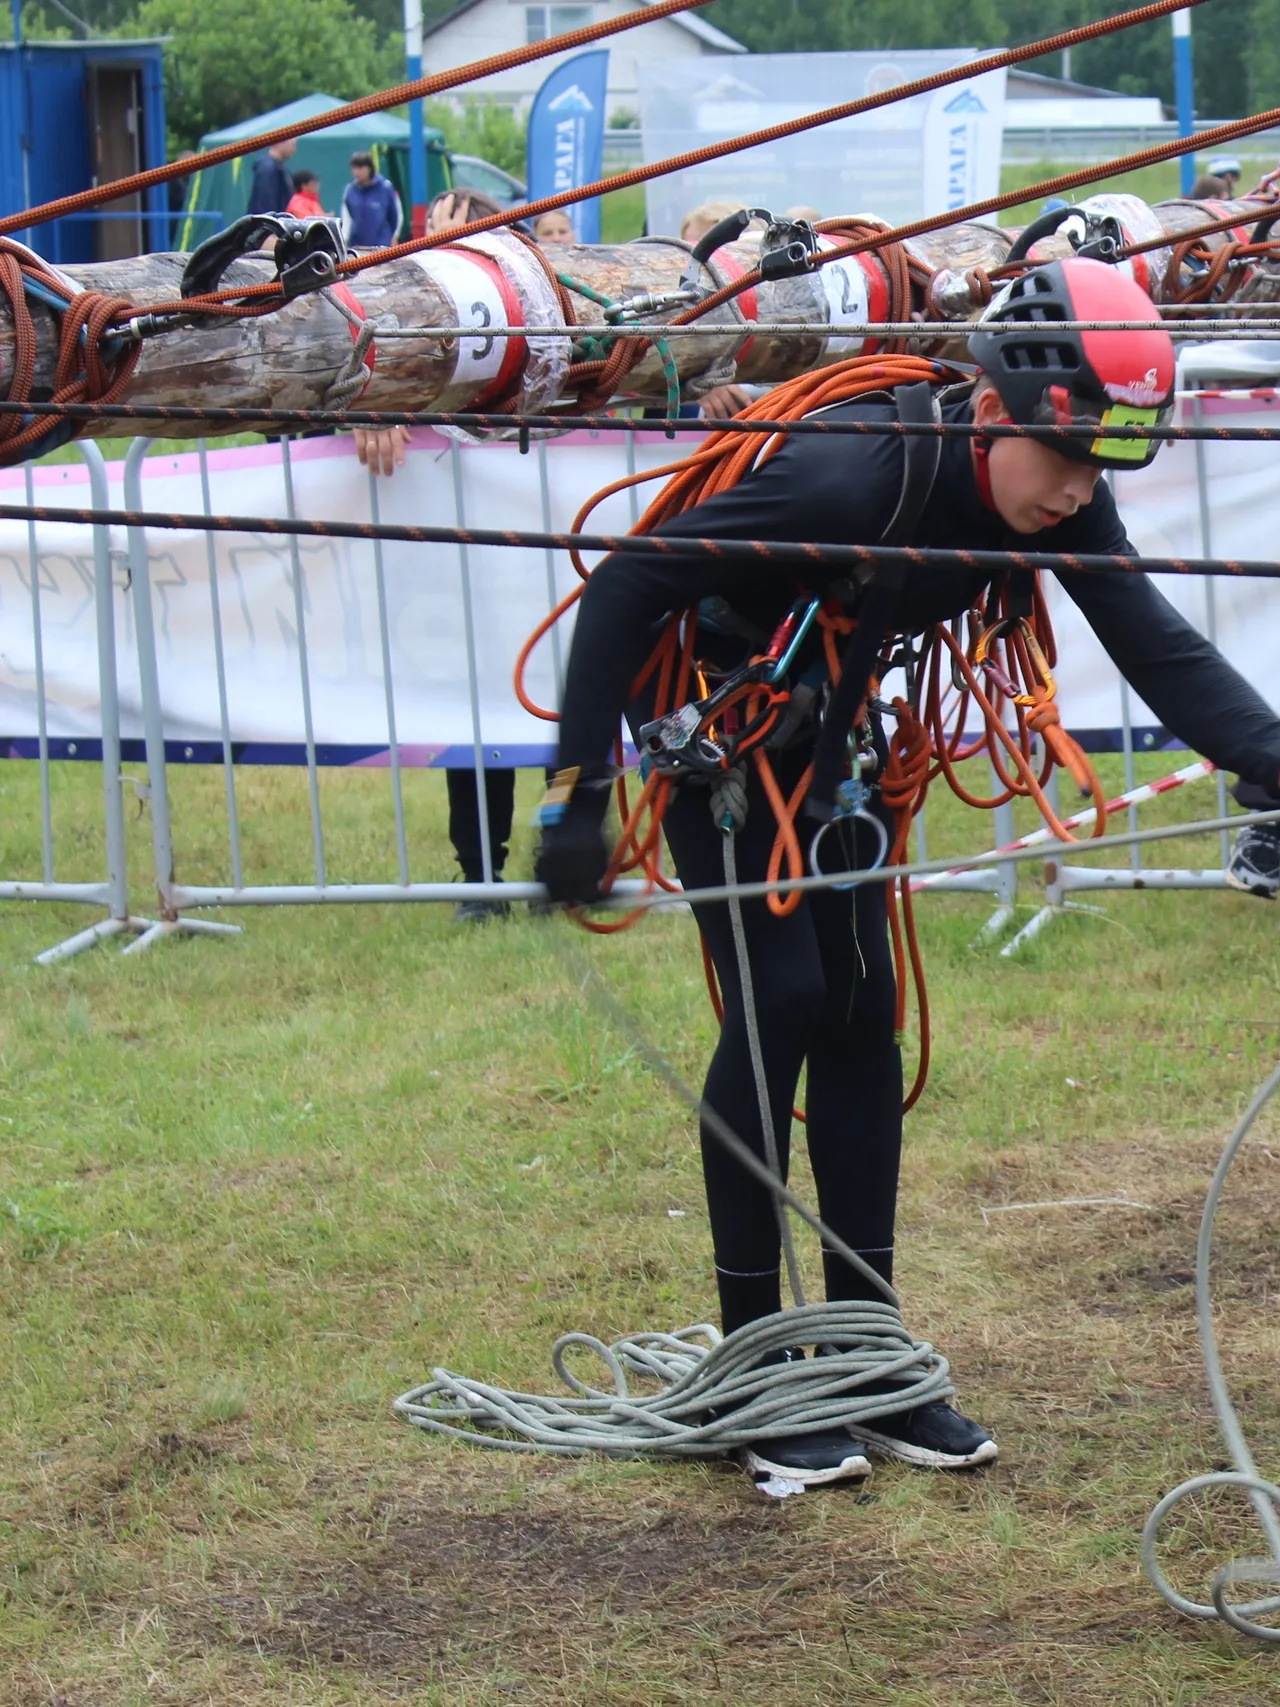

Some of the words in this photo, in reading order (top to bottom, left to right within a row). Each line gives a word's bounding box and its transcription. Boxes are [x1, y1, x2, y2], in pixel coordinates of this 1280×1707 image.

[554, 118, 575, 194] РАГА
[831, 264, 858, 314] 2
[470, 300, 494, 361] 3
